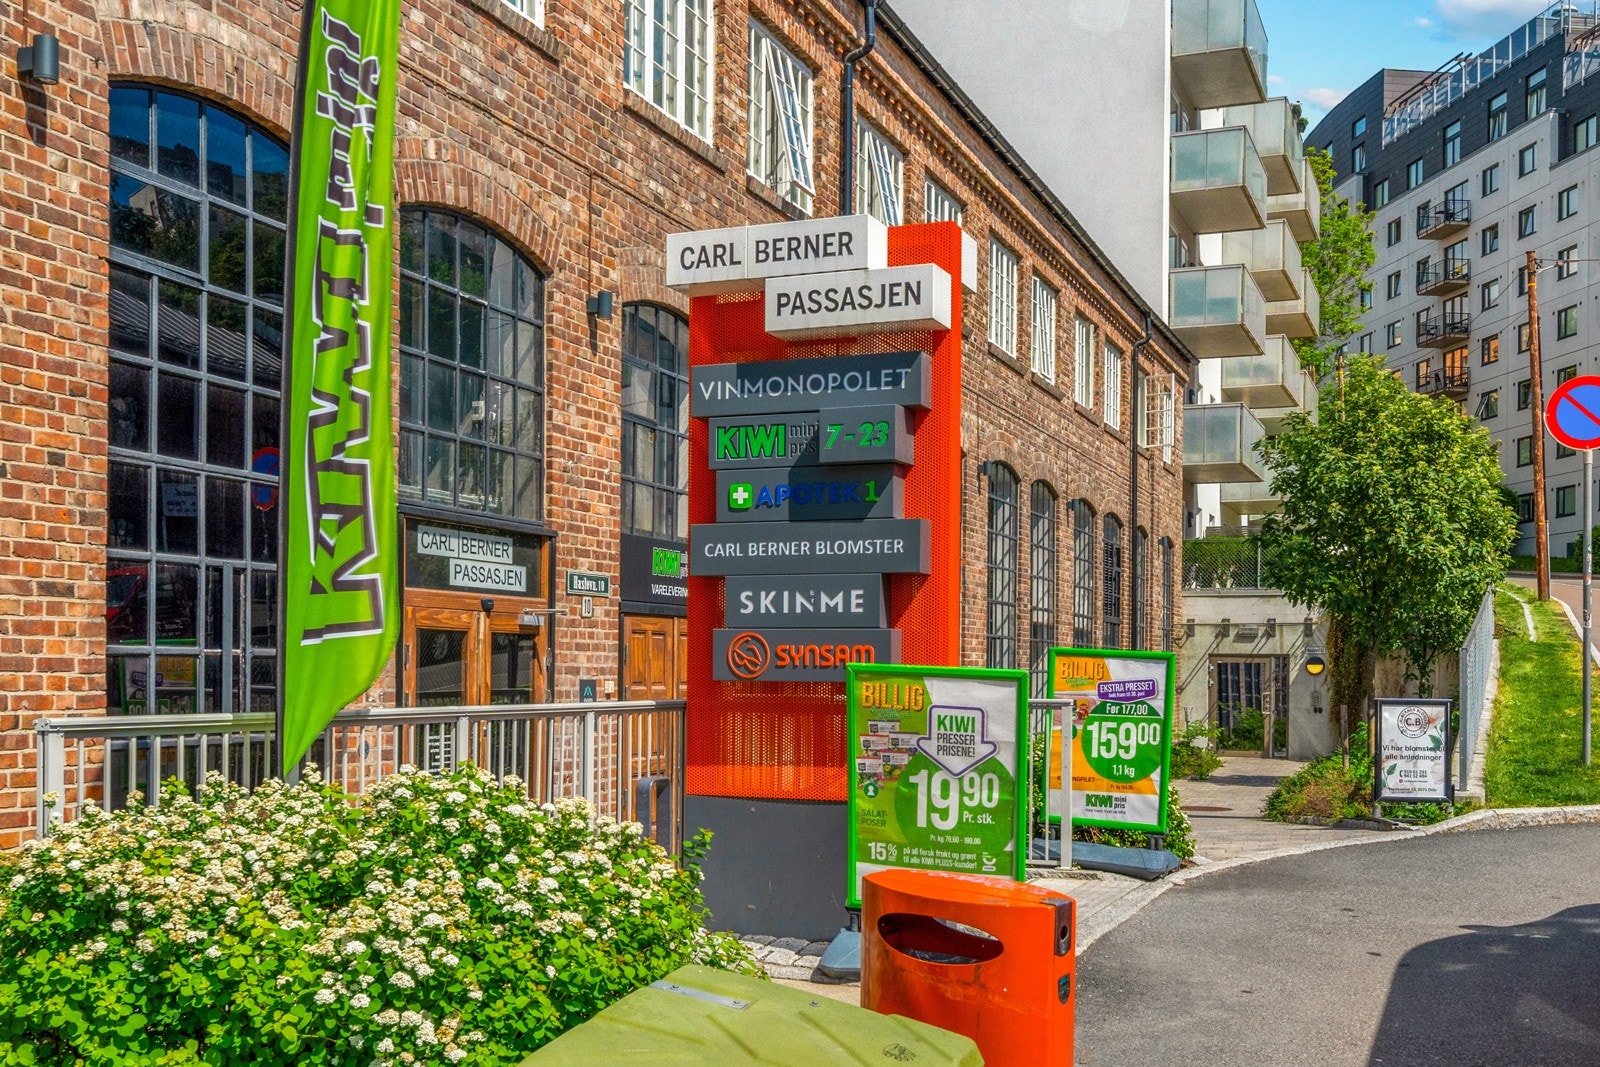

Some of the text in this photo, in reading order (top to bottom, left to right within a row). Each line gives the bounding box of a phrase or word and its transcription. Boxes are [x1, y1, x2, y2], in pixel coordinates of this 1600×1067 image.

[680, 231, 854, 271] CARL BERNER
[776, 280, 922, 317] PASSASJEN
[699, 368, 911, 400] VINMONOPOLET
[788, 421, 819, 438] mini
[716, 423, 787, 460] KIWI
[824, 424, 844, 450] 7
[858, 421, 890, 448] 23
[788, 439, 816, 458] pris
[754, 480, 879, 508] APOTEK 1
[421, 531, 511, 560] CARL BERNER
[704, 539, 905, 558] CARL BERNER BLOMSTER
[652, 547, 681, 578] KIWI
[453, 563, 523, 587] PASSASJEN
[598, 580, 605, 592] 10
[584, 598, 591, 614] 10
[775, 644, 875, 669] SYNSAM
[1060, 661, 1105, 681] BILLIG
[1100, 683, 1125, 694] EKSTRA
[1125, 681, 1154, 692] PRESSET
[861, 681, 925, 712] BILLIG
[1106, 703, 1149, 716] Før 177,00
[937, 714, 976, 733] KIWI
[936, 732, 976, 746] PRESSER
[936, 744, 976, 758] PRISENE!
[1399, 754, 1442, 762] anledninger
[1113, 764, 1135, 778] 1,1 kg
[1085, 794, 1127, 809] KIWI mini
[1113, 802, 1126, 810] pris
[861, 808, 888, 819] SALAT-
[963, 811, 995, 824] Pr. stk.
[861, 817, 887, 828] POSER
[910, 856, 921, 864] alle
[919, 848, 935, 857] fersk
[935, 850, 951, 859] frukt
